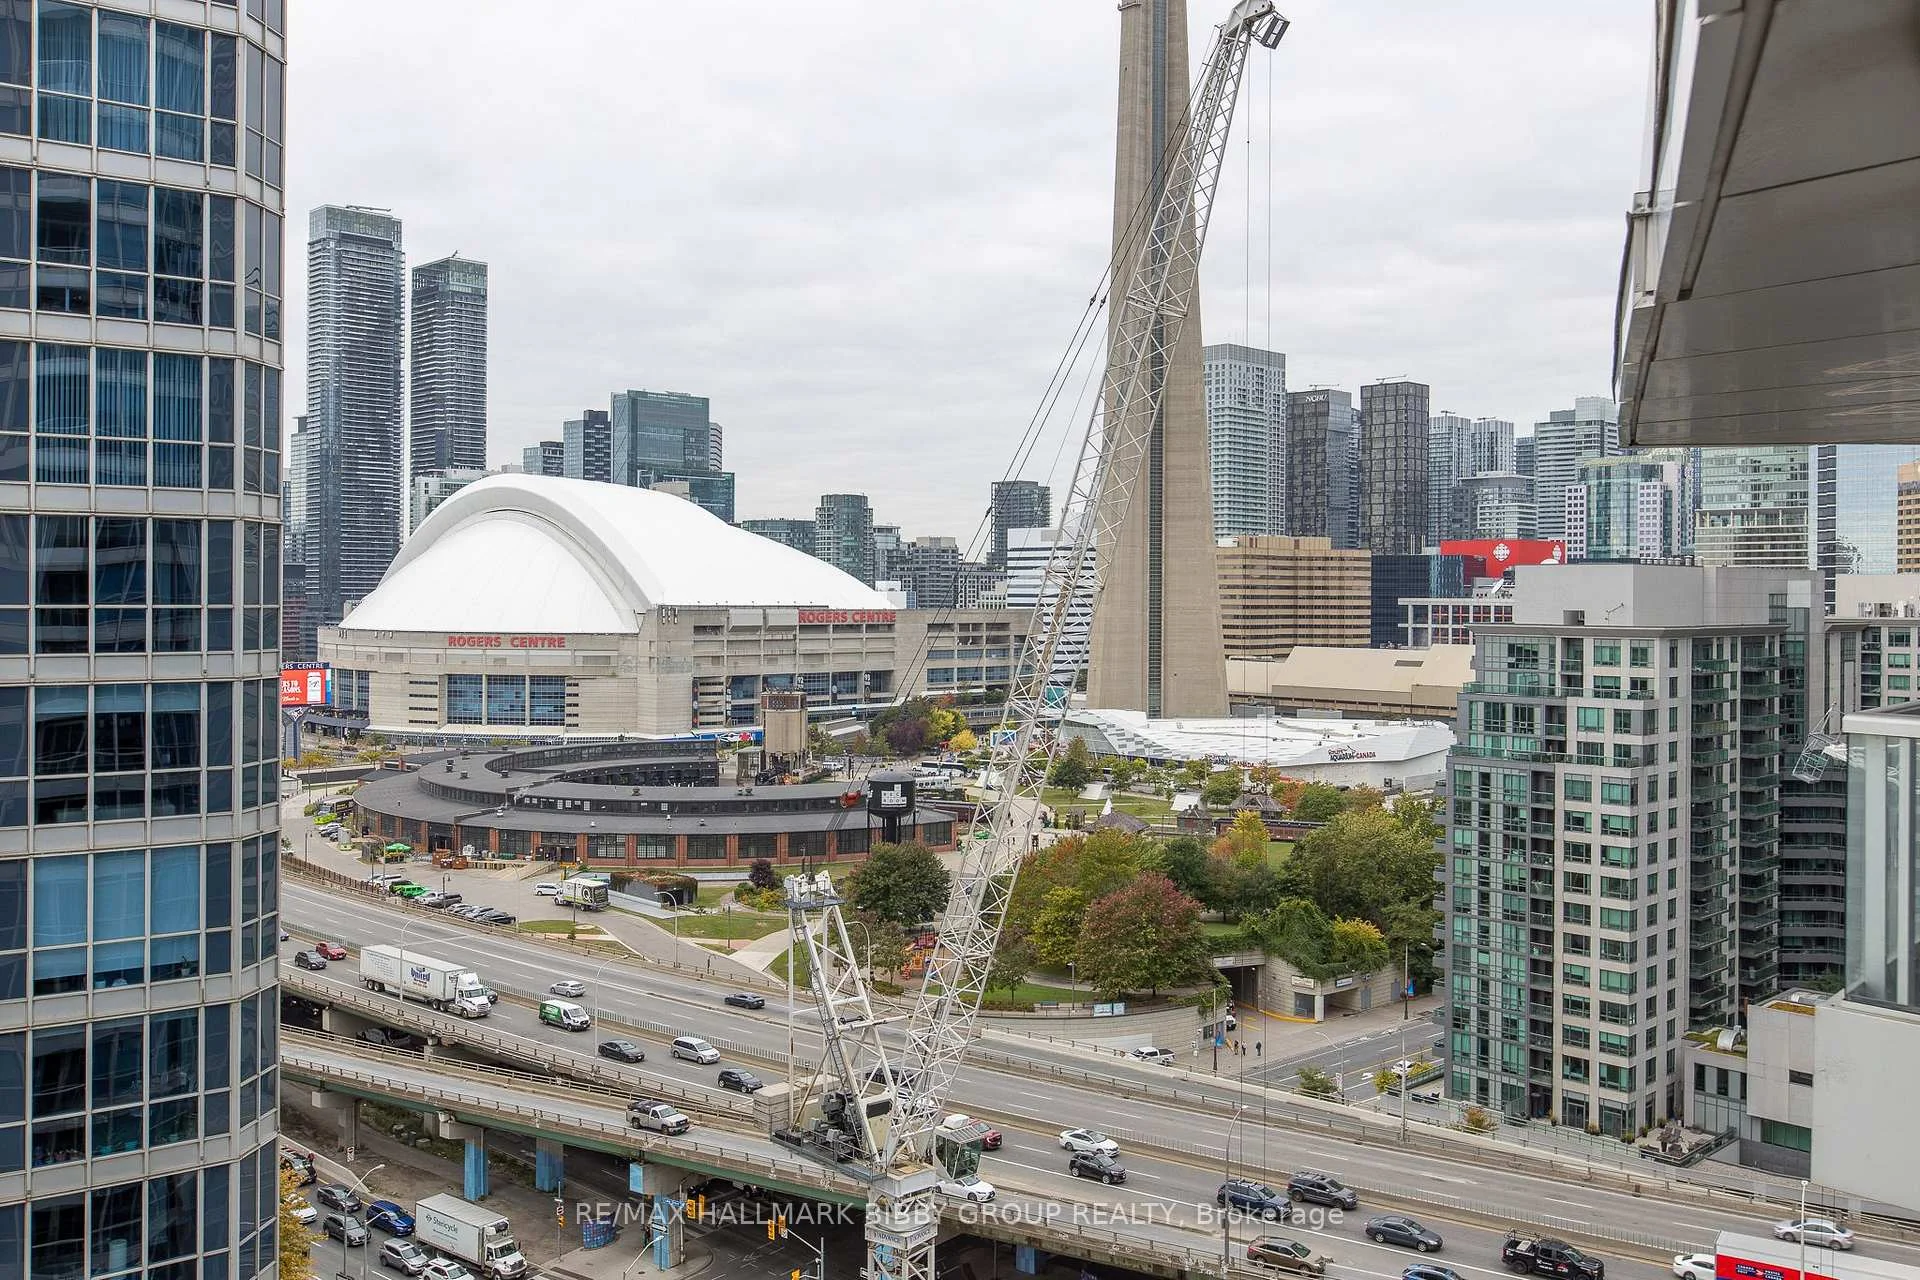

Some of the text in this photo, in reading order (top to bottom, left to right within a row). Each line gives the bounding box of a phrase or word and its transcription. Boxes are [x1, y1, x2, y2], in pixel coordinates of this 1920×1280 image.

[798, 610, 896, 623] ROGERS CENTRE
[448, 635, 565, 648] ROGERS CENTRE
